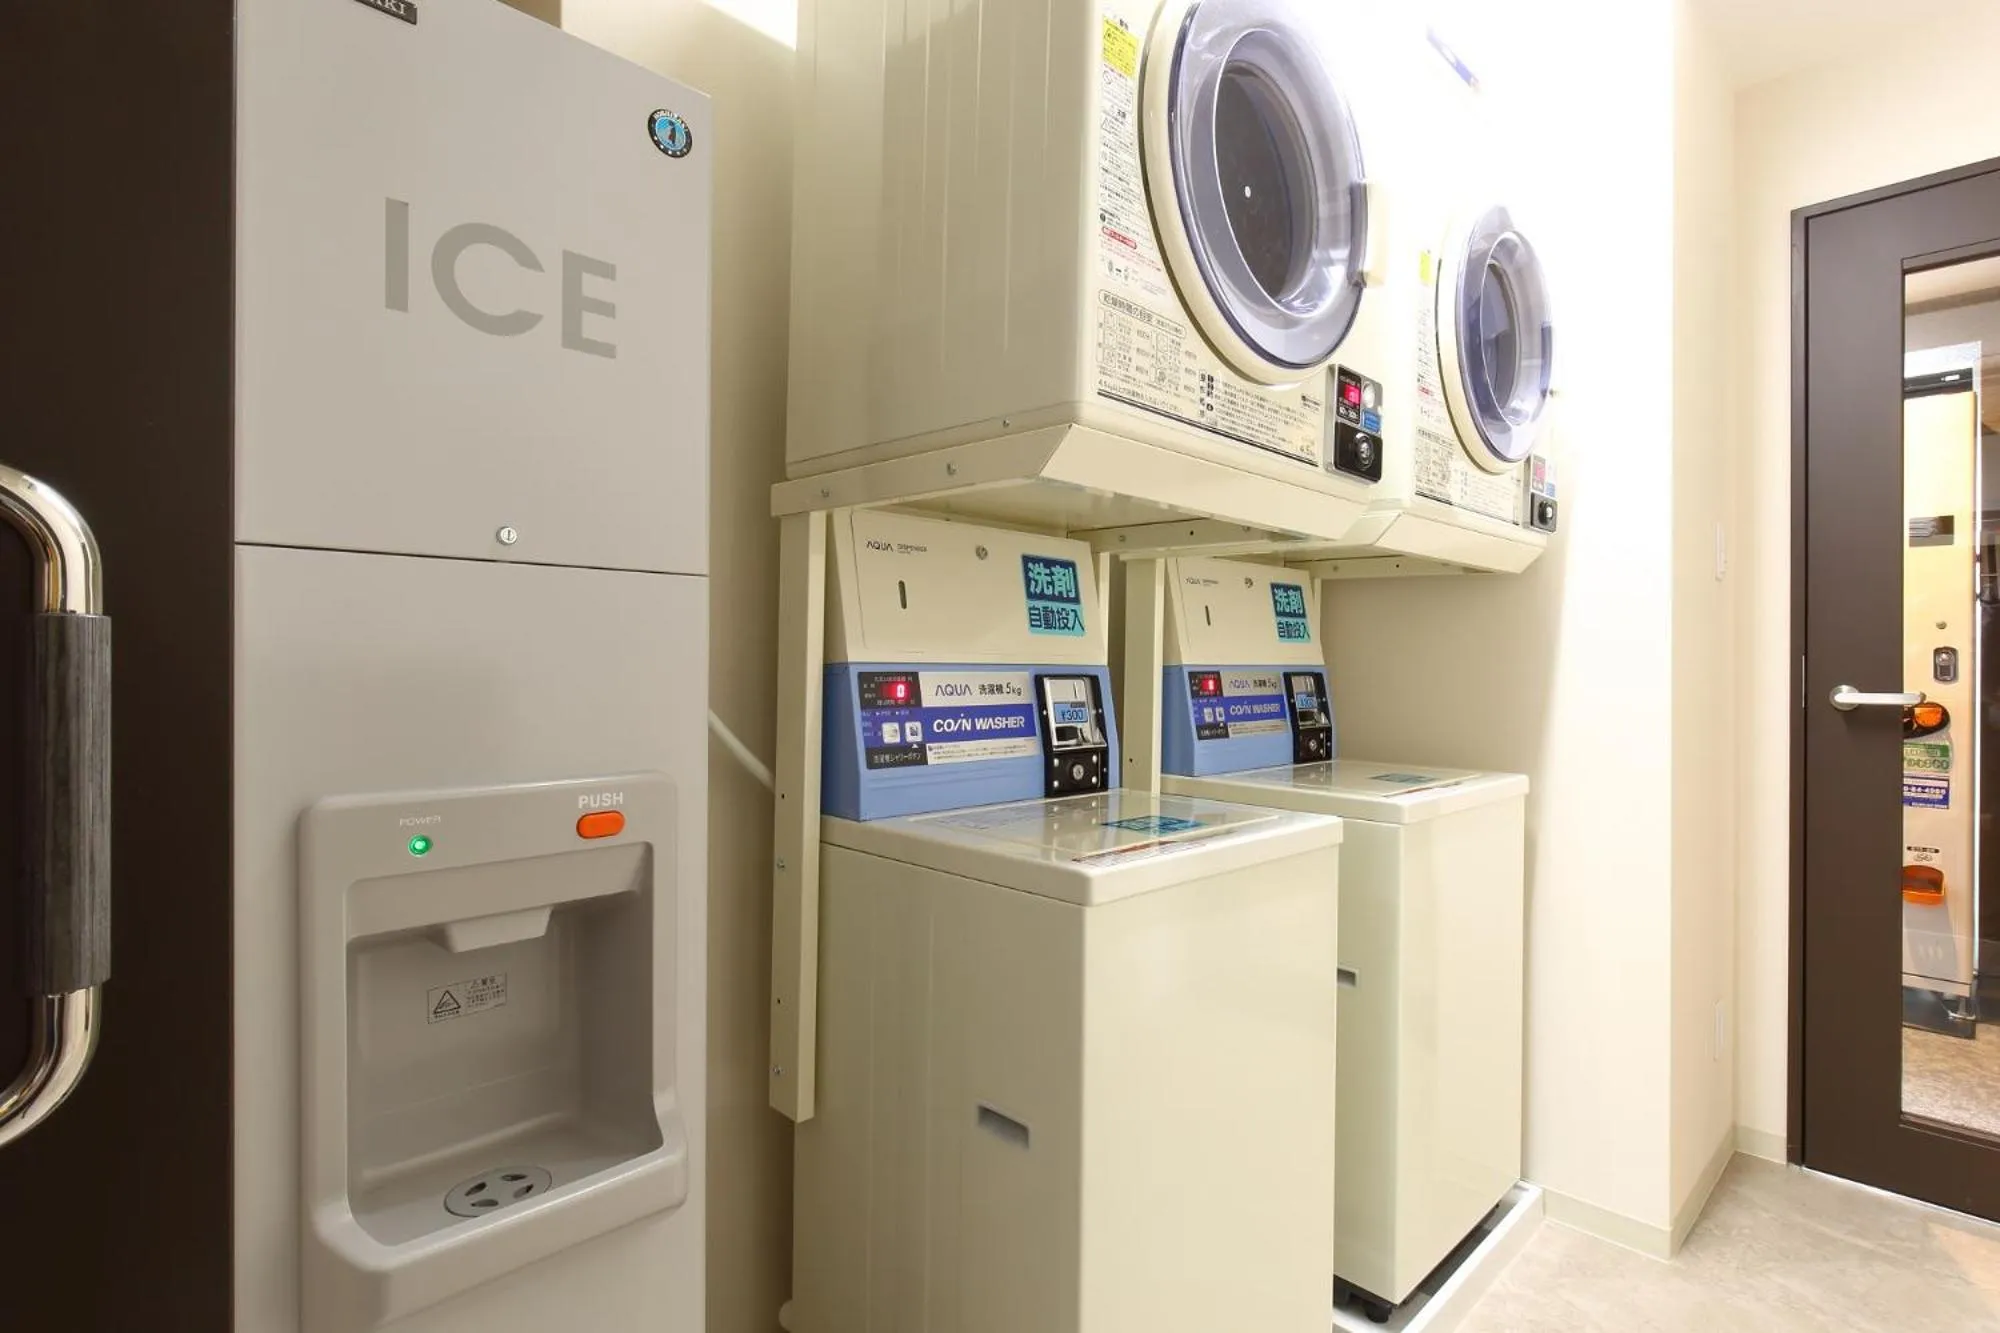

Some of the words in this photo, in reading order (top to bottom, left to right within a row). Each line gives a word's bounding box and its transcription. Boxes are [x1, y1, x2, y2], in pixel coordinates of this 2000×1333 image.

[385, 197, 617, 359] ICE
[866, 540, 894, 553] AQUA
[1028, 562, 1076, 598] 洗剤
[1029, 604, 1085, 632] 自動投入
[935, 683, 973, 697] AQUA
[1006, 682, 1022, 697] 5kg
[933, 713, 972, 733] COIN
[975, 716, 1025, 731] WASHER
[578, 791, 623, 809] PUSH
[399, 815, 441, 827] POWER
